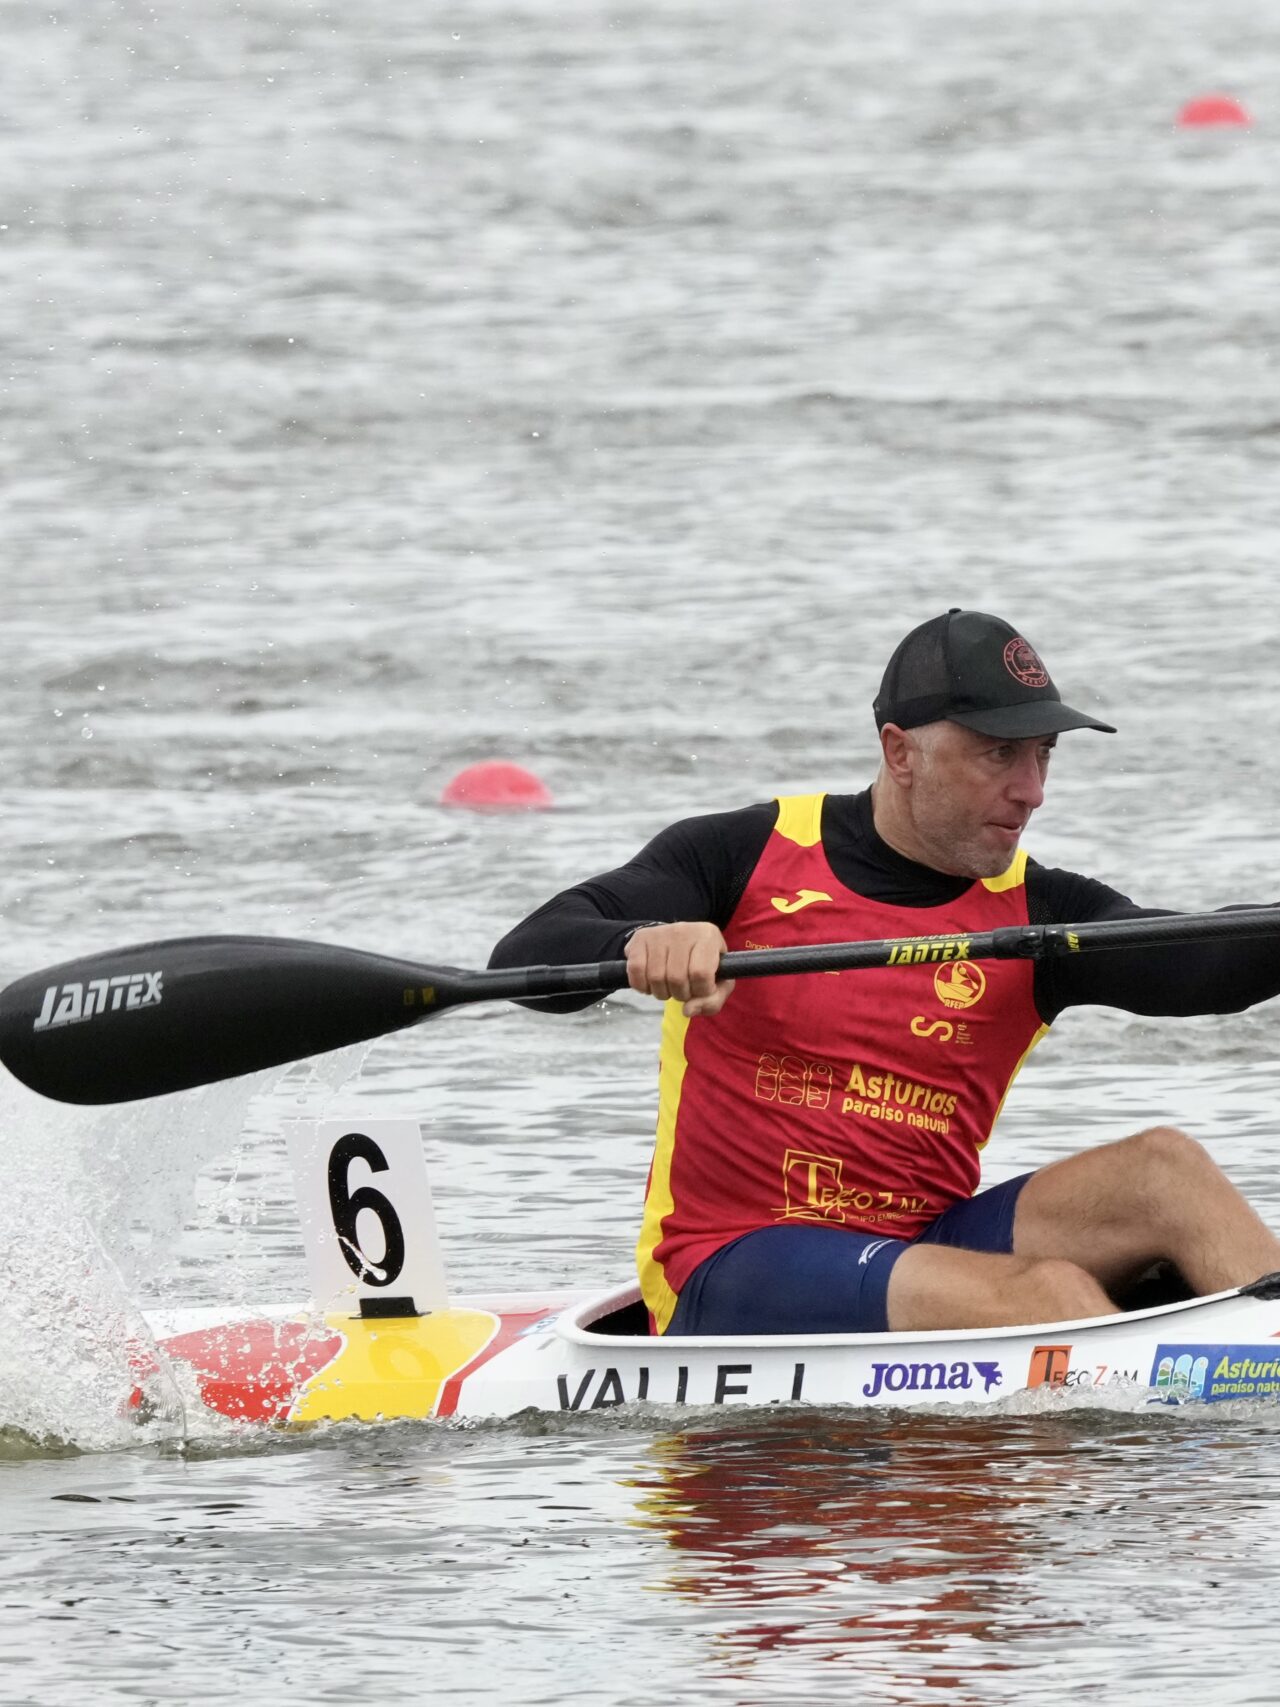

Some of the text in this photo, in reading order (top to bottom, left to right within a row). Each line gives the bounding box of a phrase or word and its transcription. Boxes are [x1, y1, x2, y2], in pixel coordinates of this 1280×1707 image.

[844, 1064, 958, 1116] Asturias
[842, 1097, 950, 1135] paraíso natural
[327, 1132, 405, 1288] 6
[1211, 1379, 1255, 1396] paraíso
